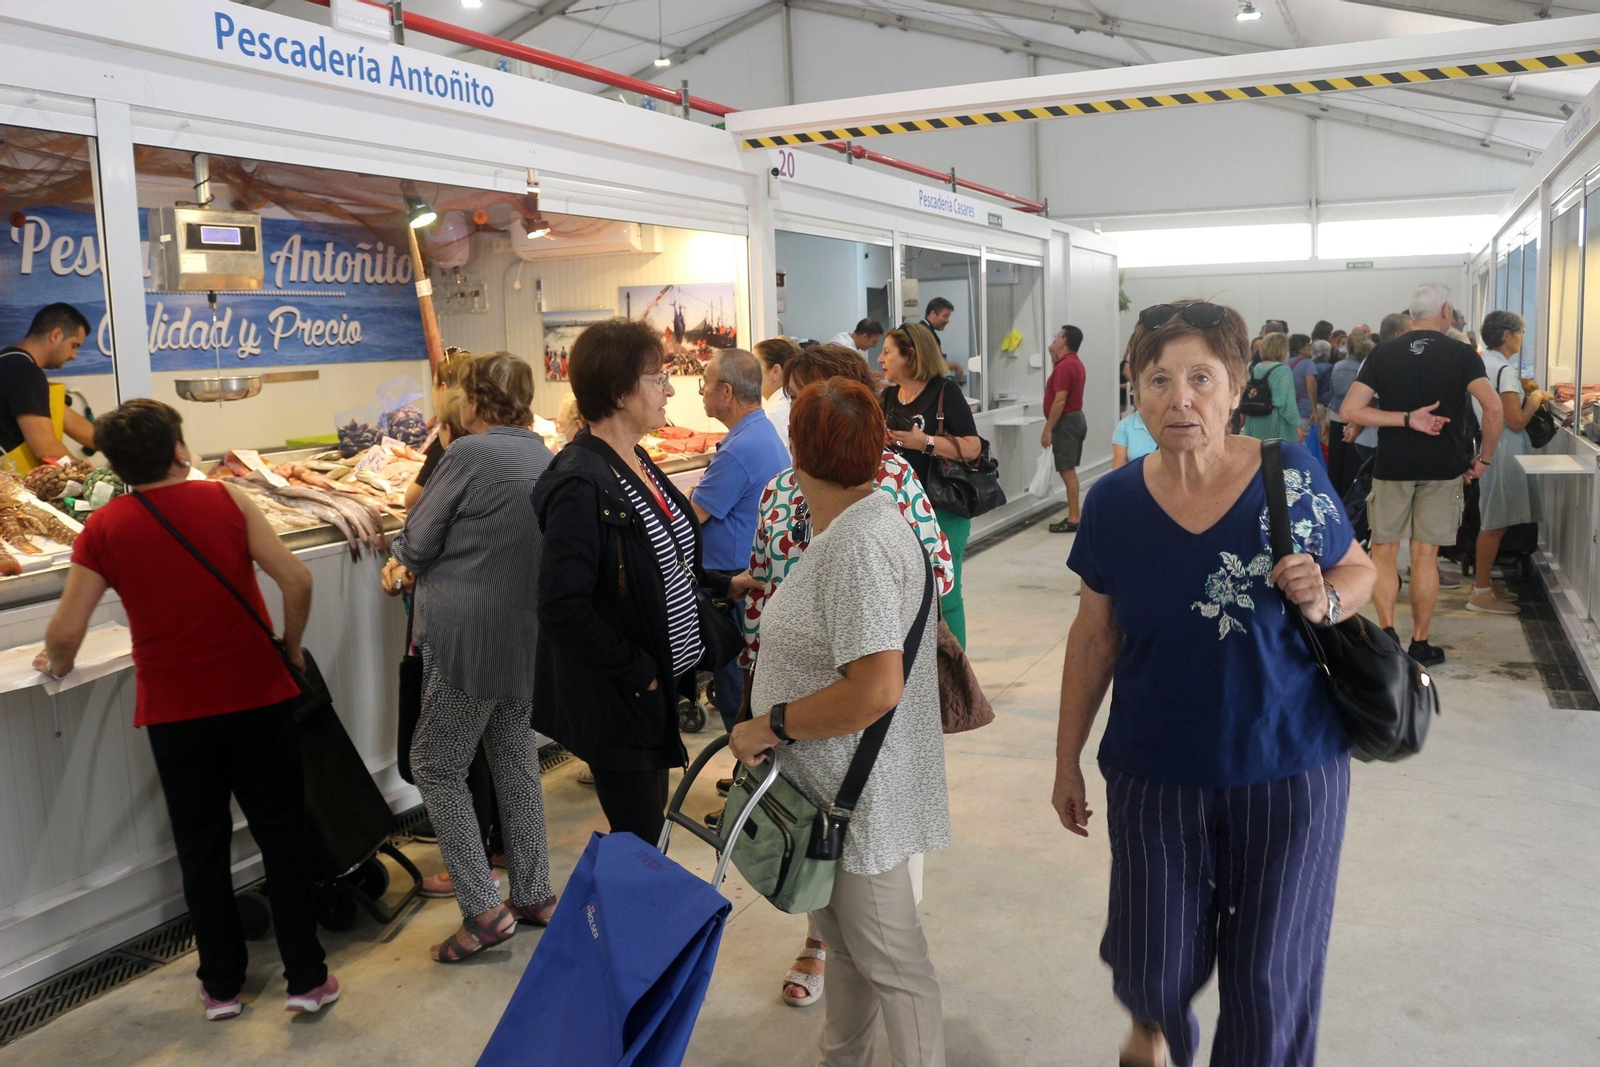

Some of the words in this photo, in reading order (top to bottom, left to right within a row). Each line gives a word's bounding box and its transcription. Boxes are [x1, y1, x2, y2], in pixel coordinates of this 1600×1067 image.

[214, 11, 381, 84] Pescadería
[389, 55, 494, 108] Antoñito
[778, 149, 795, 179] 20
[918, 189, 953, 213] Pescadería
[953, 198, 975, 218] Casares
[269, 233, 414, 289] Antoñito
[97, 301, 234, 357] Clidad
[236, 317, 262, 360] y
[267, 305, 363, 351] Precio
[586, 911, 599, 940] ROLSER
